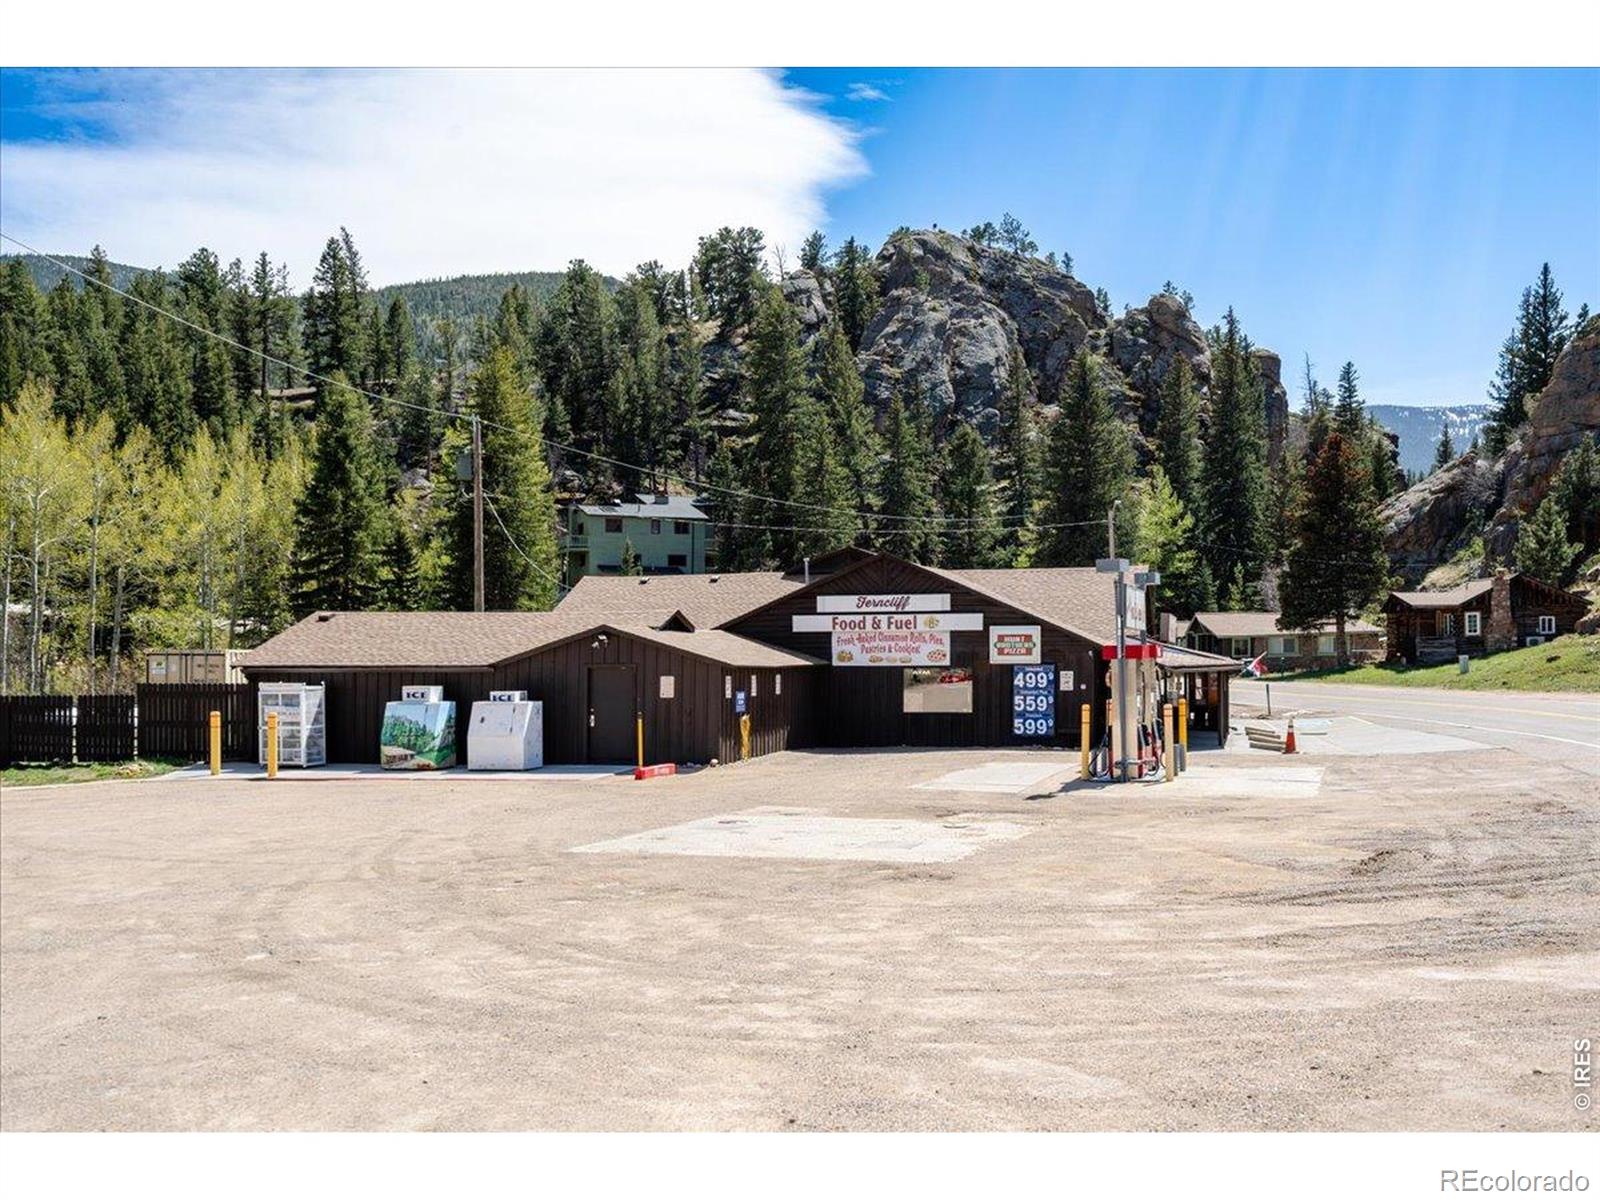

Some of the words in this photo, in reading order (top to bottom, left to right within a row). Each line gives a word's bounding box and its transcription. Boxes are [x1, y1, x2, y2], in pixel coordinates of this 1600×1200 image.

[856, 595, 911, 610] Ferncliff
[832, 615, 866, 631] Food
[871, 616, 882, 630] &
[887, 615, 917, 630] Fuel
[877, 632, 908, 643] Cinnamon
[860, 644, 886, 654] Pastries
